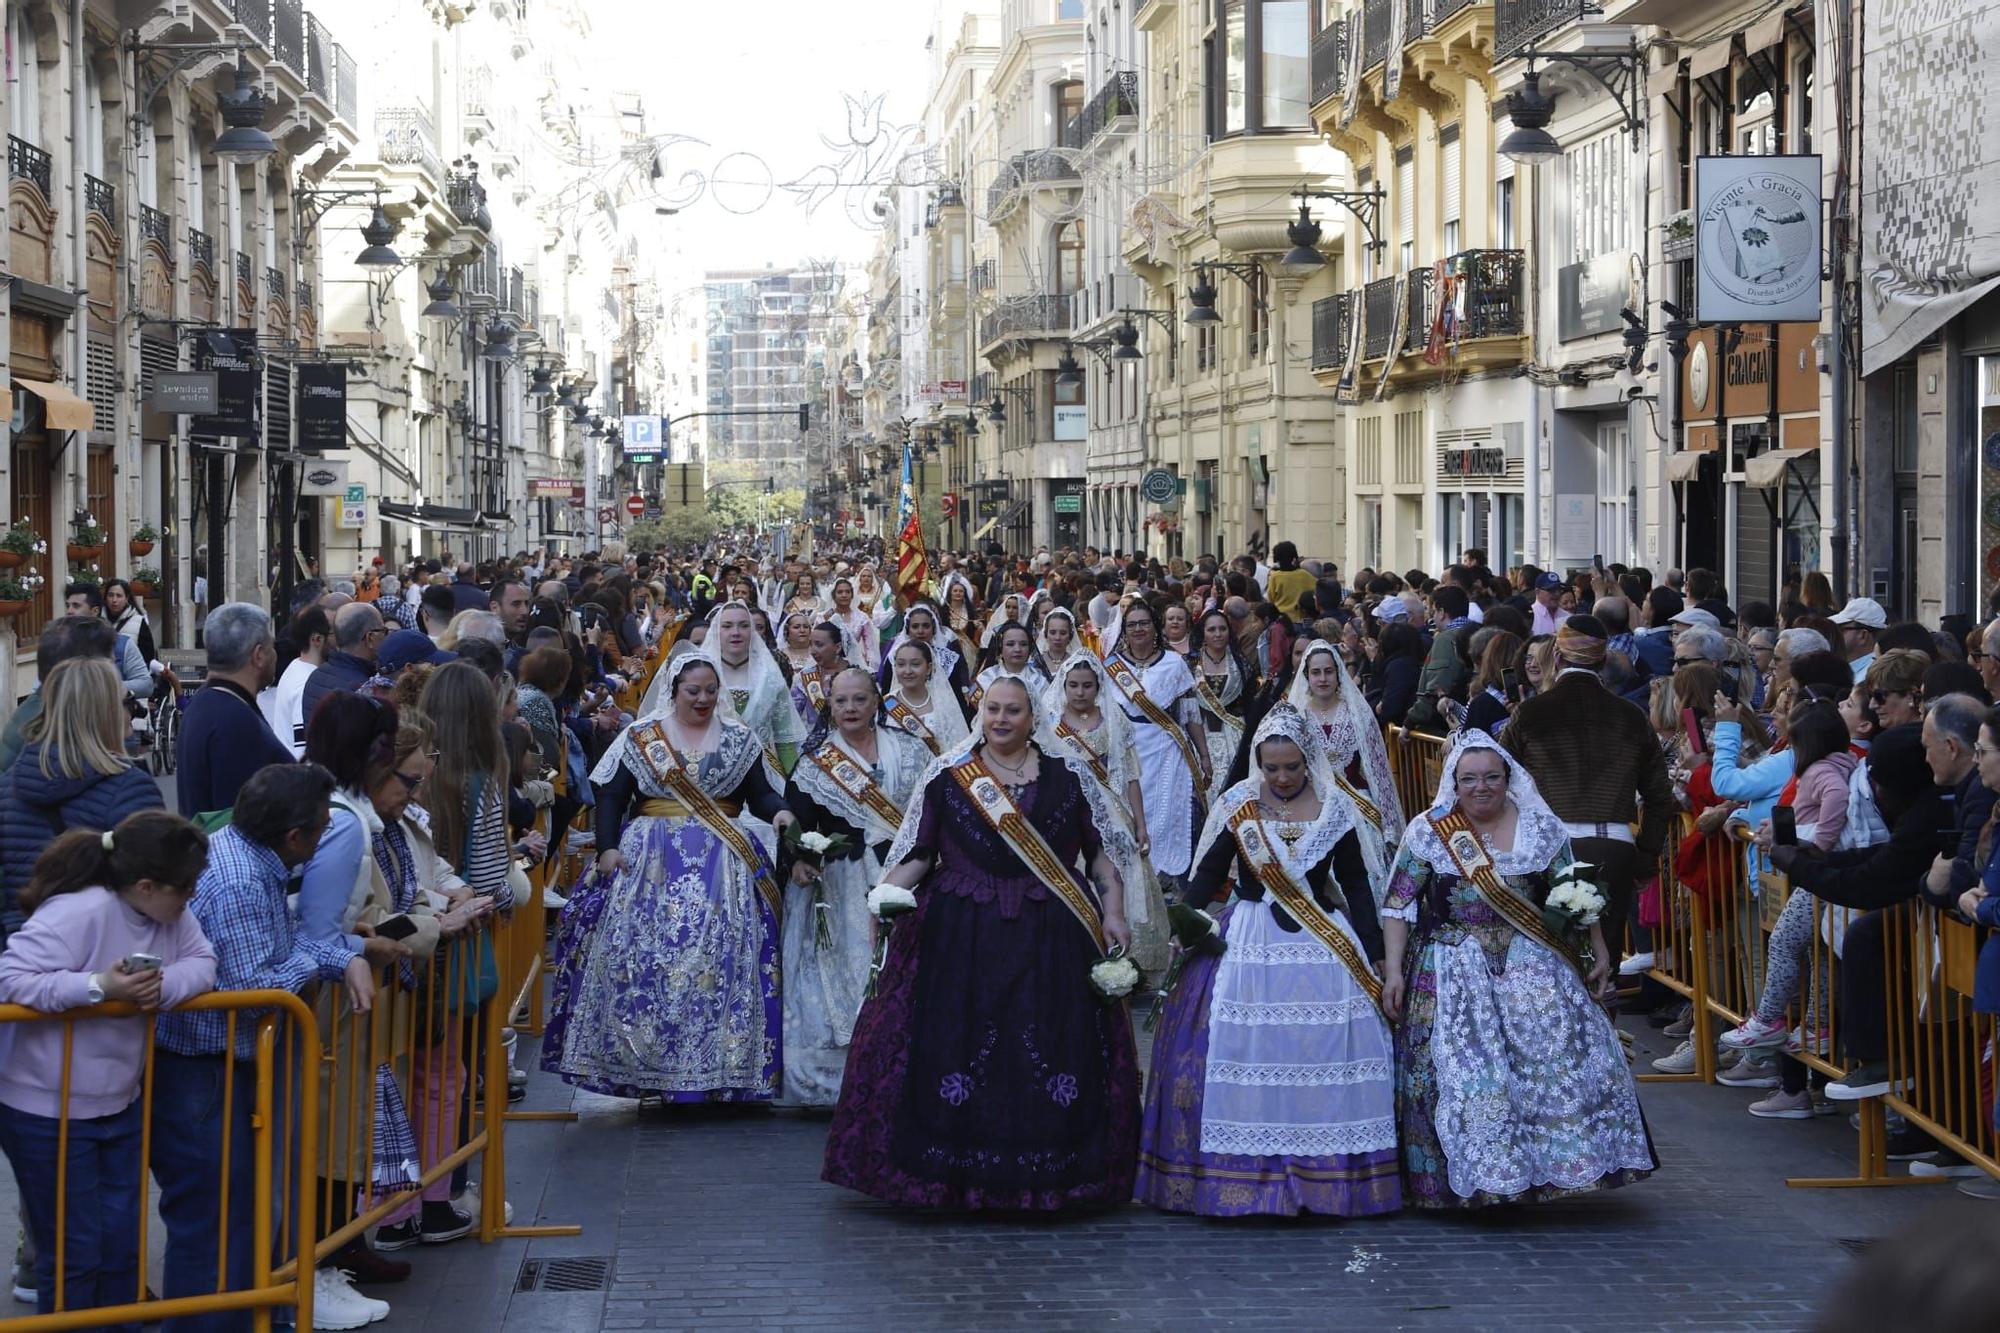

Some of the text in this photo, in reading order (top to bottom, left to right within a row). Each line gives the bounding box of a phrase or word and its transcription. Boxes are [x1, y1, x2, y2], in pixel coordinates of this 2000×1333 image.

[1704, 178, 1803, 222] Vicente Gracia
[1727, 348, 1769, 387] GRACIA
[636, 422, 649, 441] P
